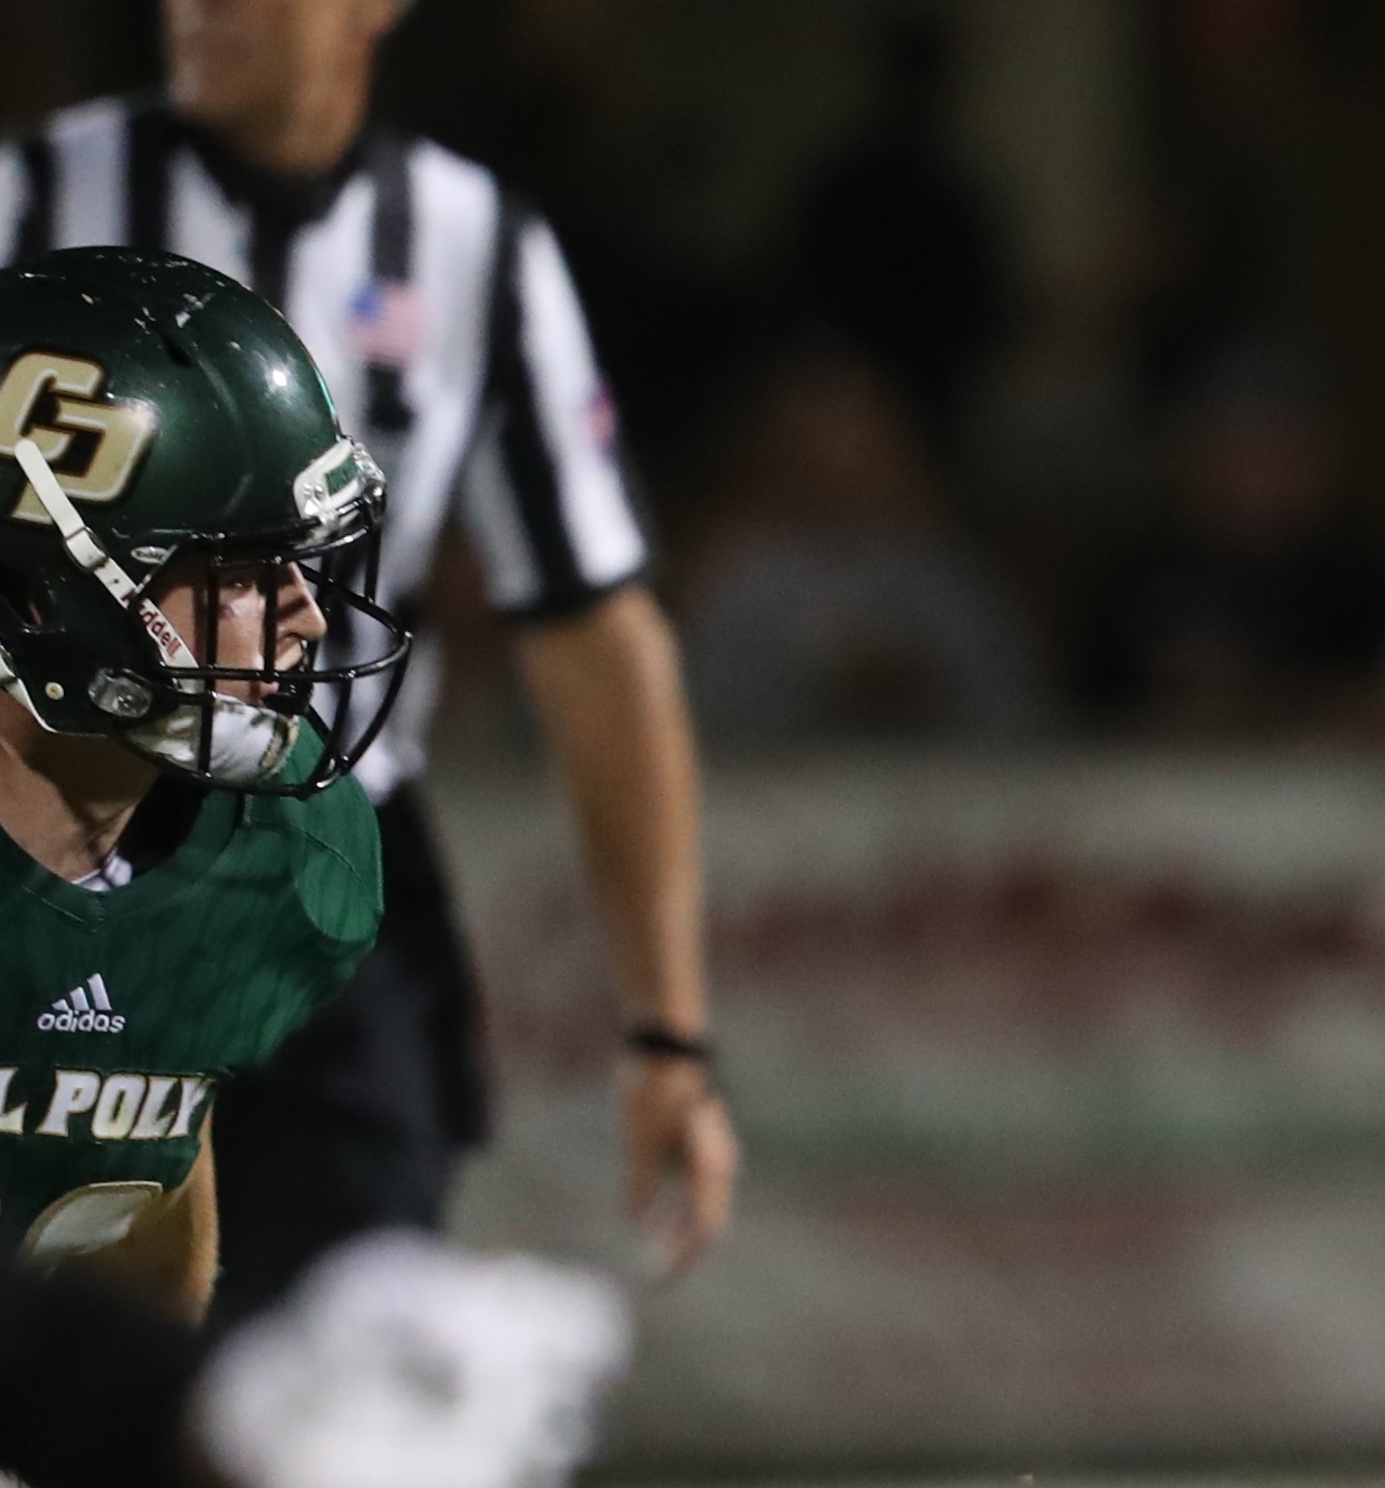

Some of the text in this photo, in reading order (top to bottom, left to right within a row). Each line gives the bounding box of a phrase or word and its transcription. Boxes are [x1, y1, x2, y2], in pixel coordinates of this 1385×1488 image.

[121, 589, 181, 656] ddell
[37, 1009, 126, 1034] adidas
[36, 1068, 209, 1140] POLY
